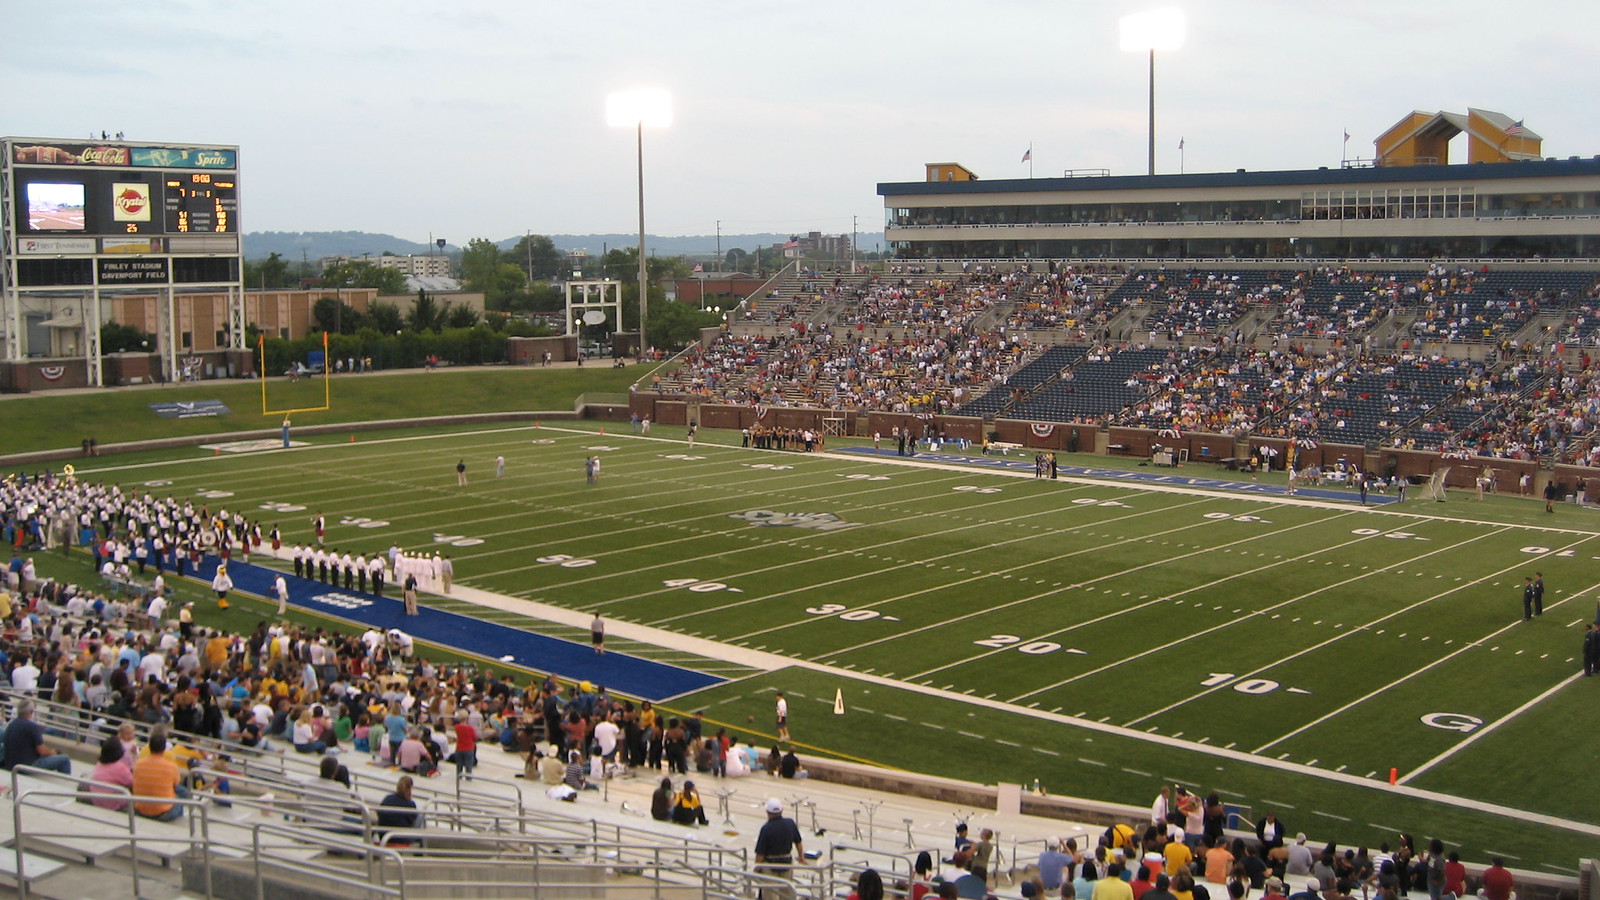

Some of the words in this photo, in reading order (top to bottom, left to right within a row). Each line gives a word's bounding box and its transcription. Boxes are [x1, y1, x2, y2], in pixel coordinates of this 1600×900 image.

[195, 151, 227, 166] Sprite
[115, 195, 148, 209] Krystal
[132, 262, 162, 270] STADIUM
[101, 272, 143, 280] DAVENPORT
[146, 271, 166, 279] FIELD
[535, 553, 598, 568] 50
[662, 577, 728, 593] 40
[805, 603, 882, 621] 30
[973, 634, 1062, 655] 20
[1200, 672, 1281, 695] 10
[1419, 712, 1484, 733] G
